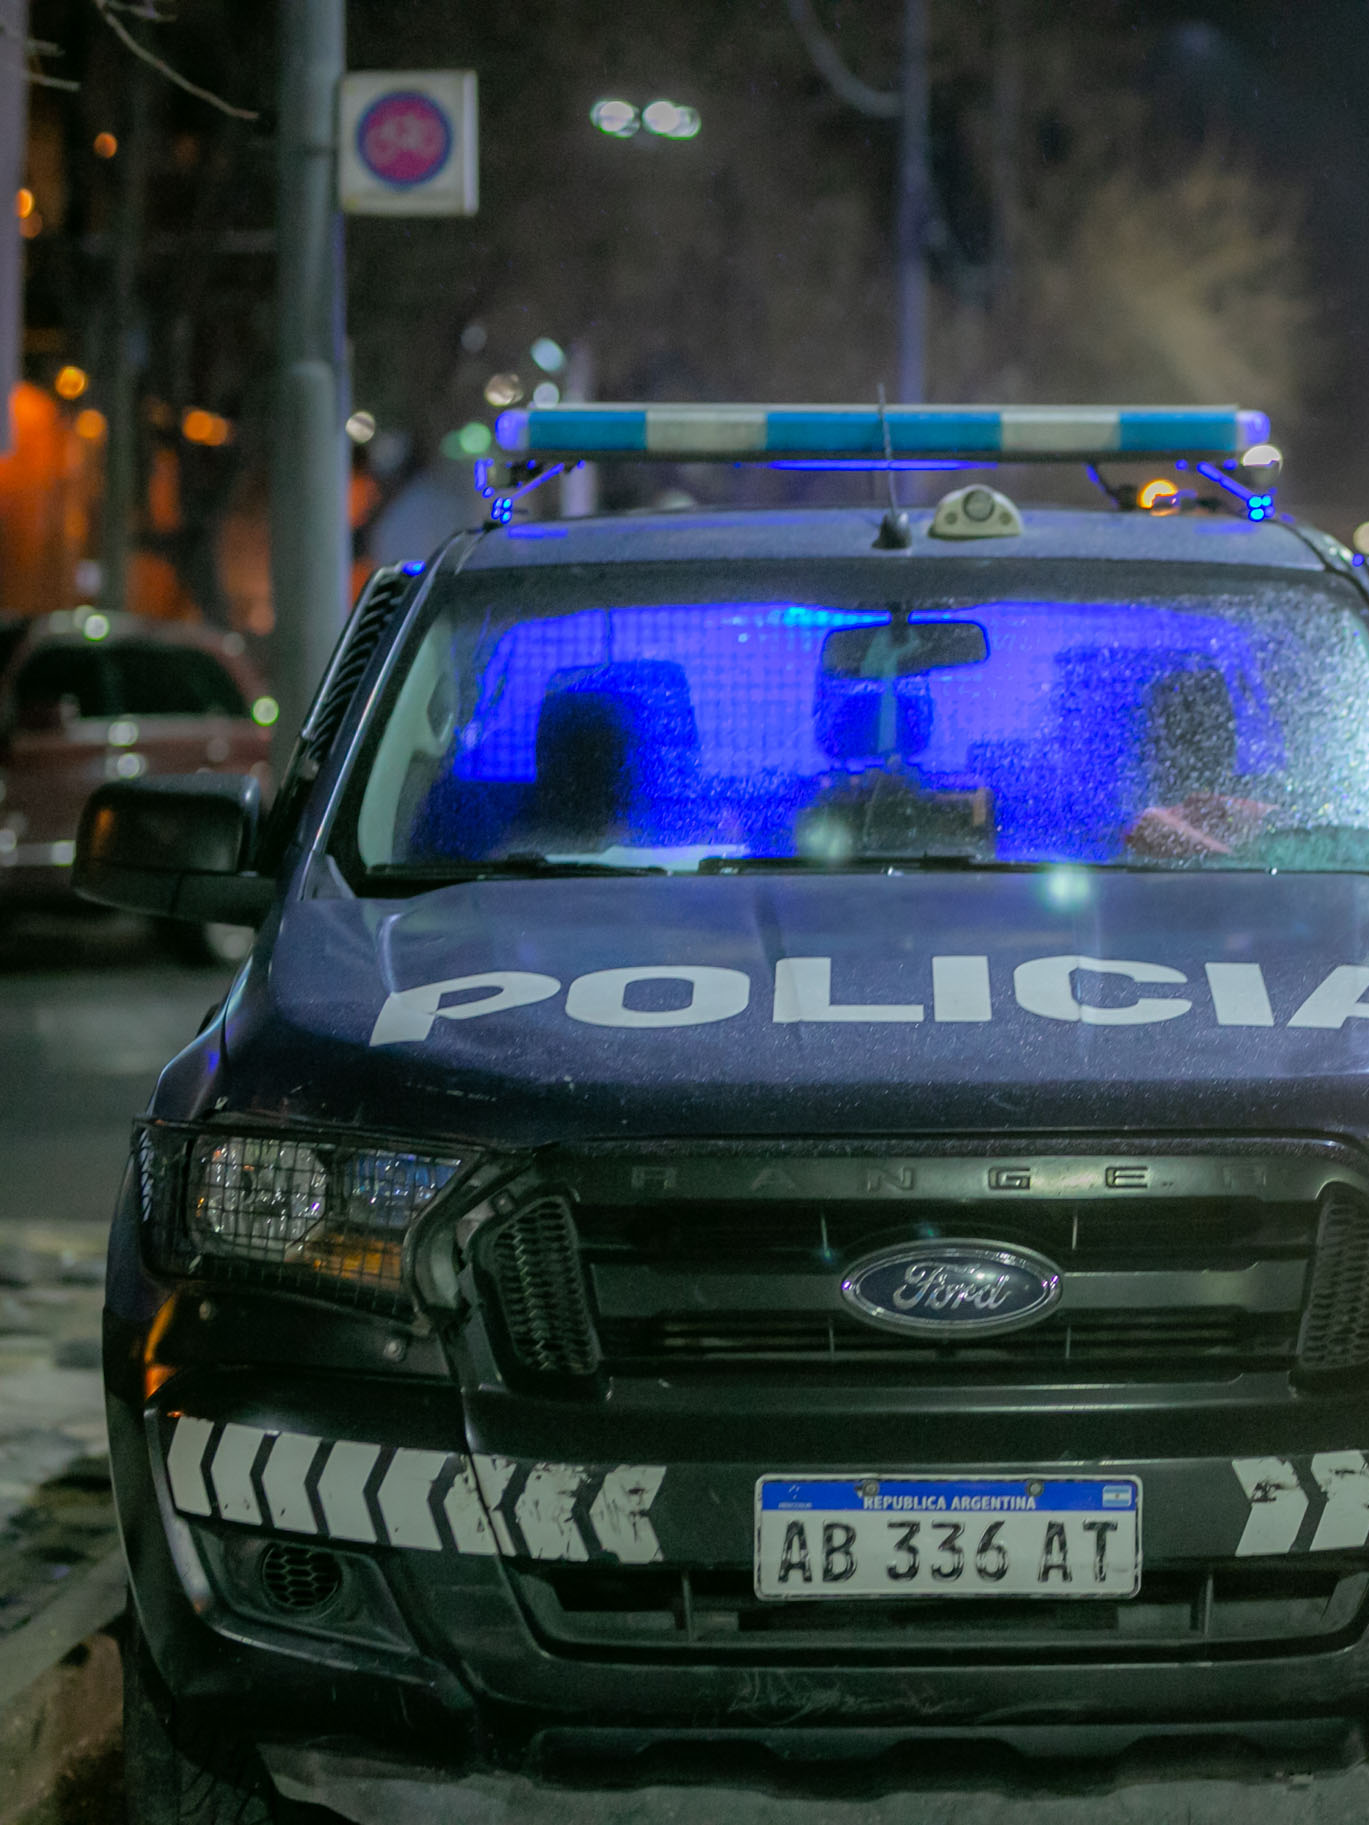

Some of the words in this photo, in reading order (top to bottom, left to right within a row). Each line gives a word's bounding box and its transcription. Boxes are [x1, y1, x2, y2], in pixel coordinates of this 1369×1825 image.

[893, 1261, 1011, 1310] Ford
[863, 1496, 947, 1509] REPUBLICA
[951, 1496, 1036, 1510] ARGENTINA
[778, 1520, 857, 1583] AB
[887, 1520, 1009, 1582] 336
[1037, 1520, 1118, 1582] AT
